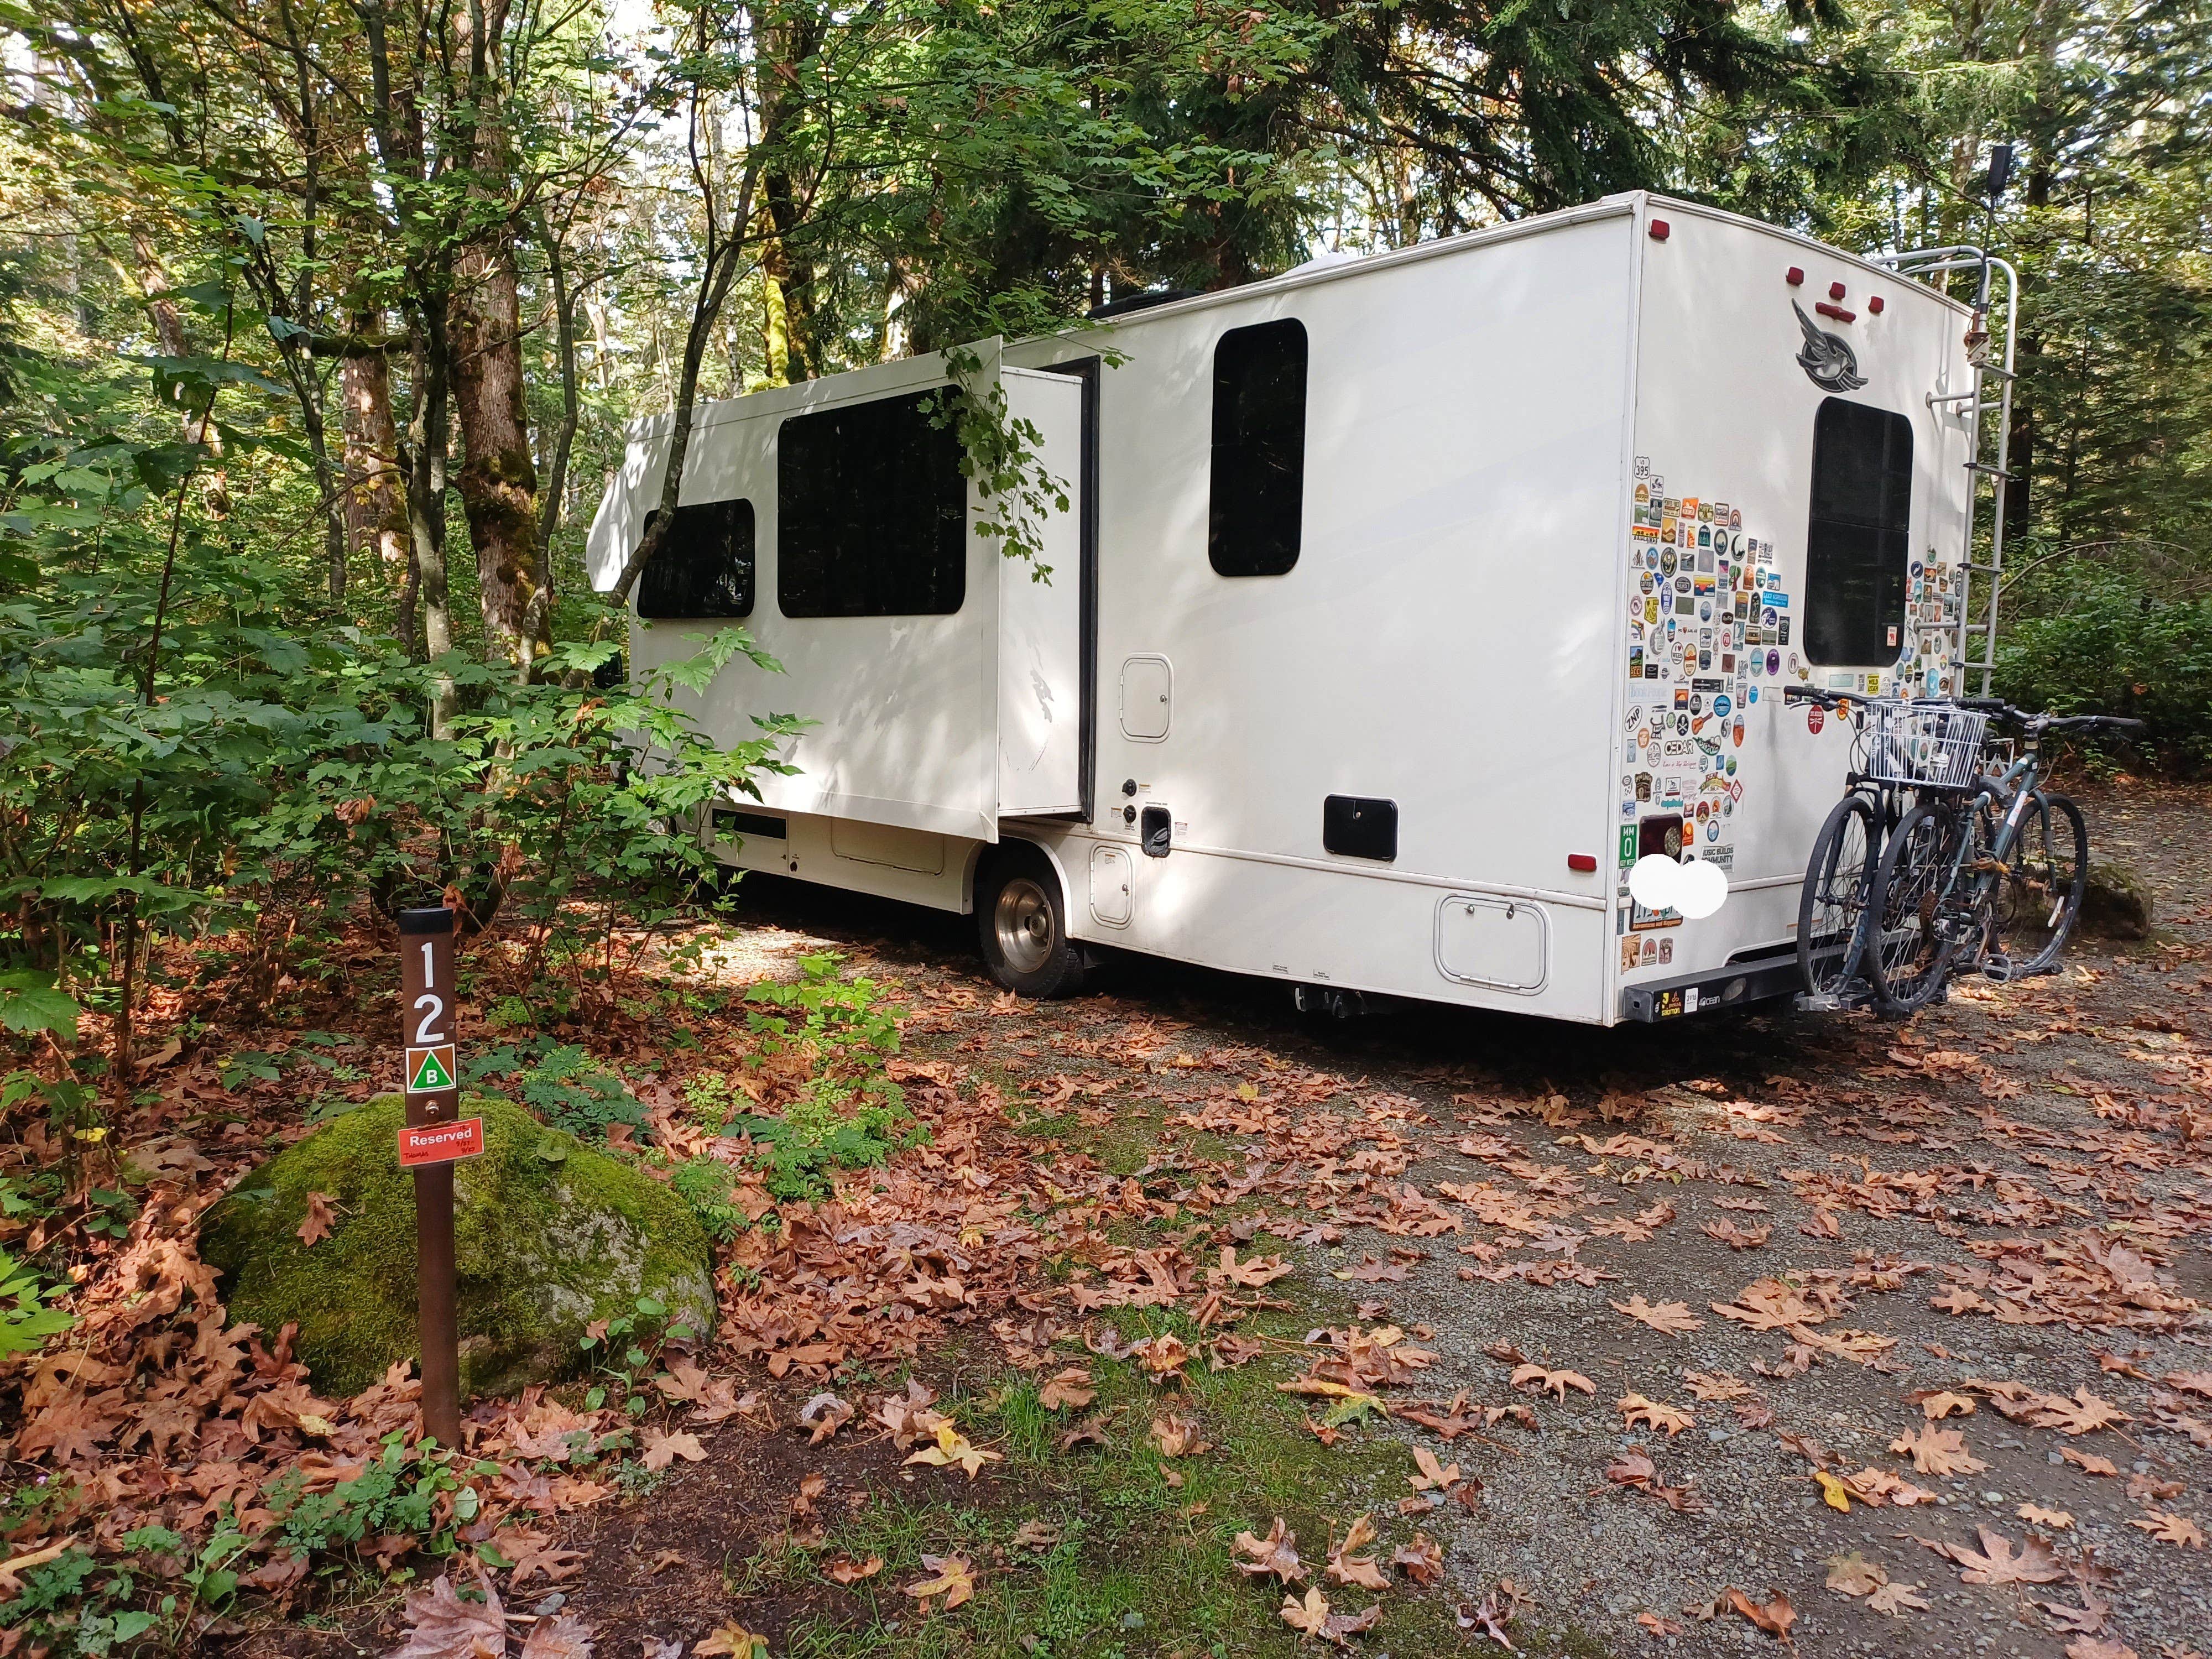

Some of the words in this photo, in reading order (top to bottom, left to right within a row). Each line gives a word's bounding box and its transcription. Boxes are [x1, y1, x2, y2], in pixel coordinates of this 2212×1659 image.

[1636, 466, 1648, 476] 395
[1626, 708, 1640, 729] ZNP
[1665, 739, 1693, 755] CEDAR
[1623, 826, 1634, 837] MM
[1624, 837, 1632, 857] 0
[426, 1069, 437, 1084] B
[409, 1127, 472, 1147] Reserved
